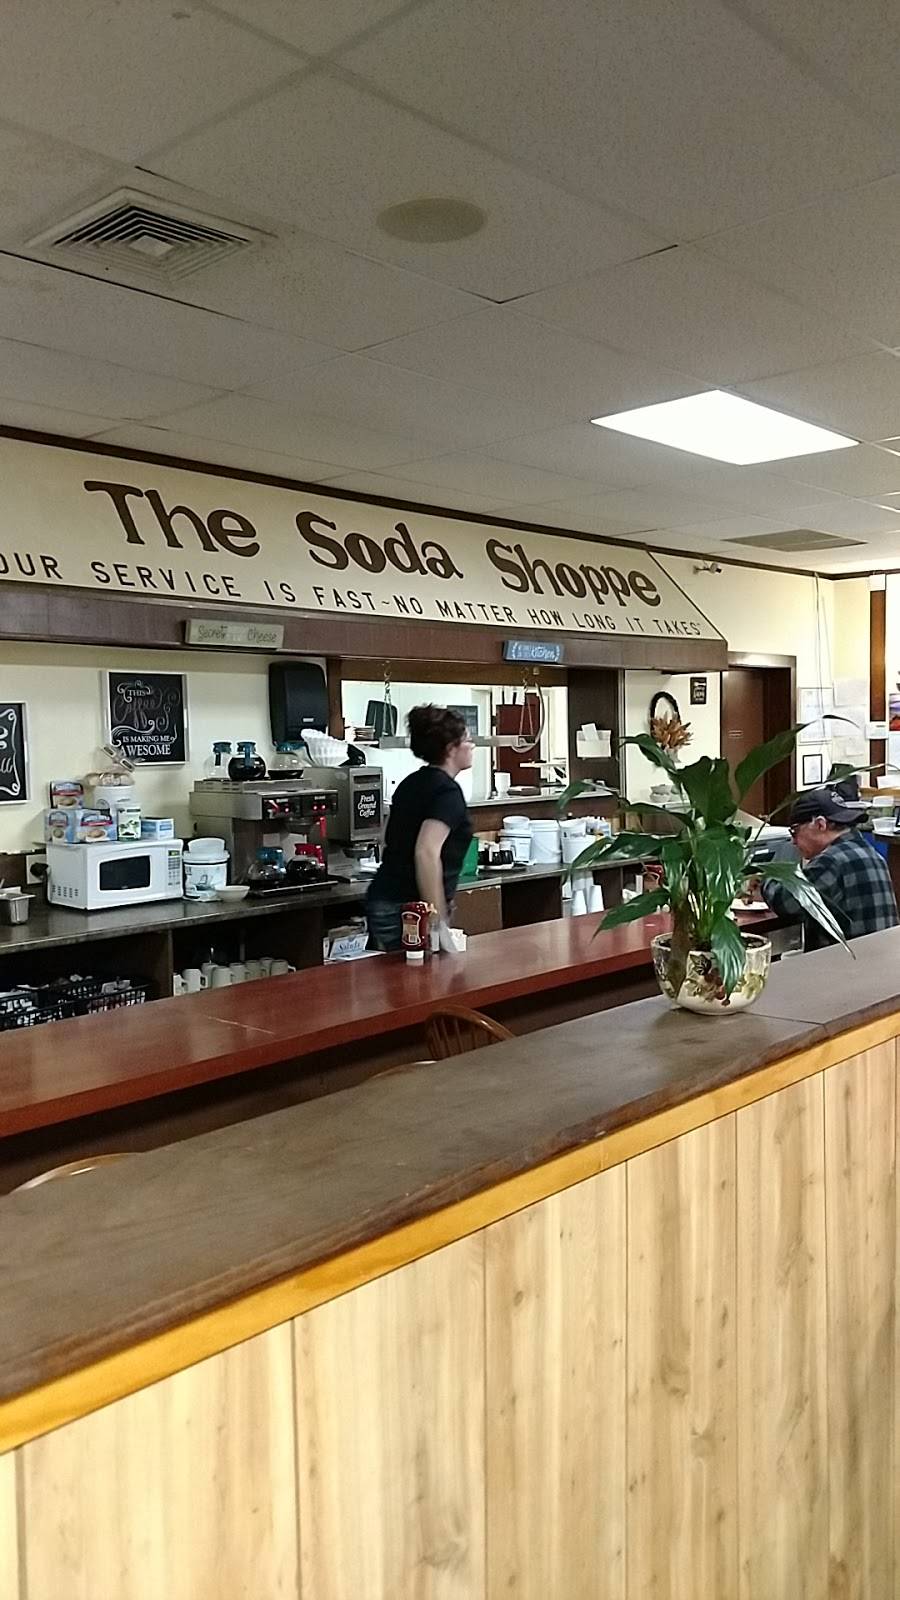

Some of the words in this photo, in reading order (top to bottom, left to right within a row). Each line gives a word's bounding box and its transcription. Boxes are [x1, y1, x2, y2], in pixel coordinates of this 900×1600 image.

[84, 480, 260, 557] The
[296, 511, 464, 579] Soda
[486, 539, 661, 607] Shoppe
[91, 561, 241, 597] SERVICE
[264, 580, 296, 602] IS
[435, 600, 517, 624] MATTER
[527, 609, 565, 627] HOW
[572, 612, 616, 631] LONG
[625, 616, 645, 633] IT
[247, 624, 278, 643] Cheese
[128, 689, 146, 697] THIS
[122, 735, 130, 743] IS
[130, 735, 159, 743] MAKING
[160, 735, 170, 743] ME
[120, 744, 172, 757] AWESOME
[360, 794, 375, 803] Fresh
[357, 801, 377, 810] Ground
[360, 809, 376, 817] Coffee
